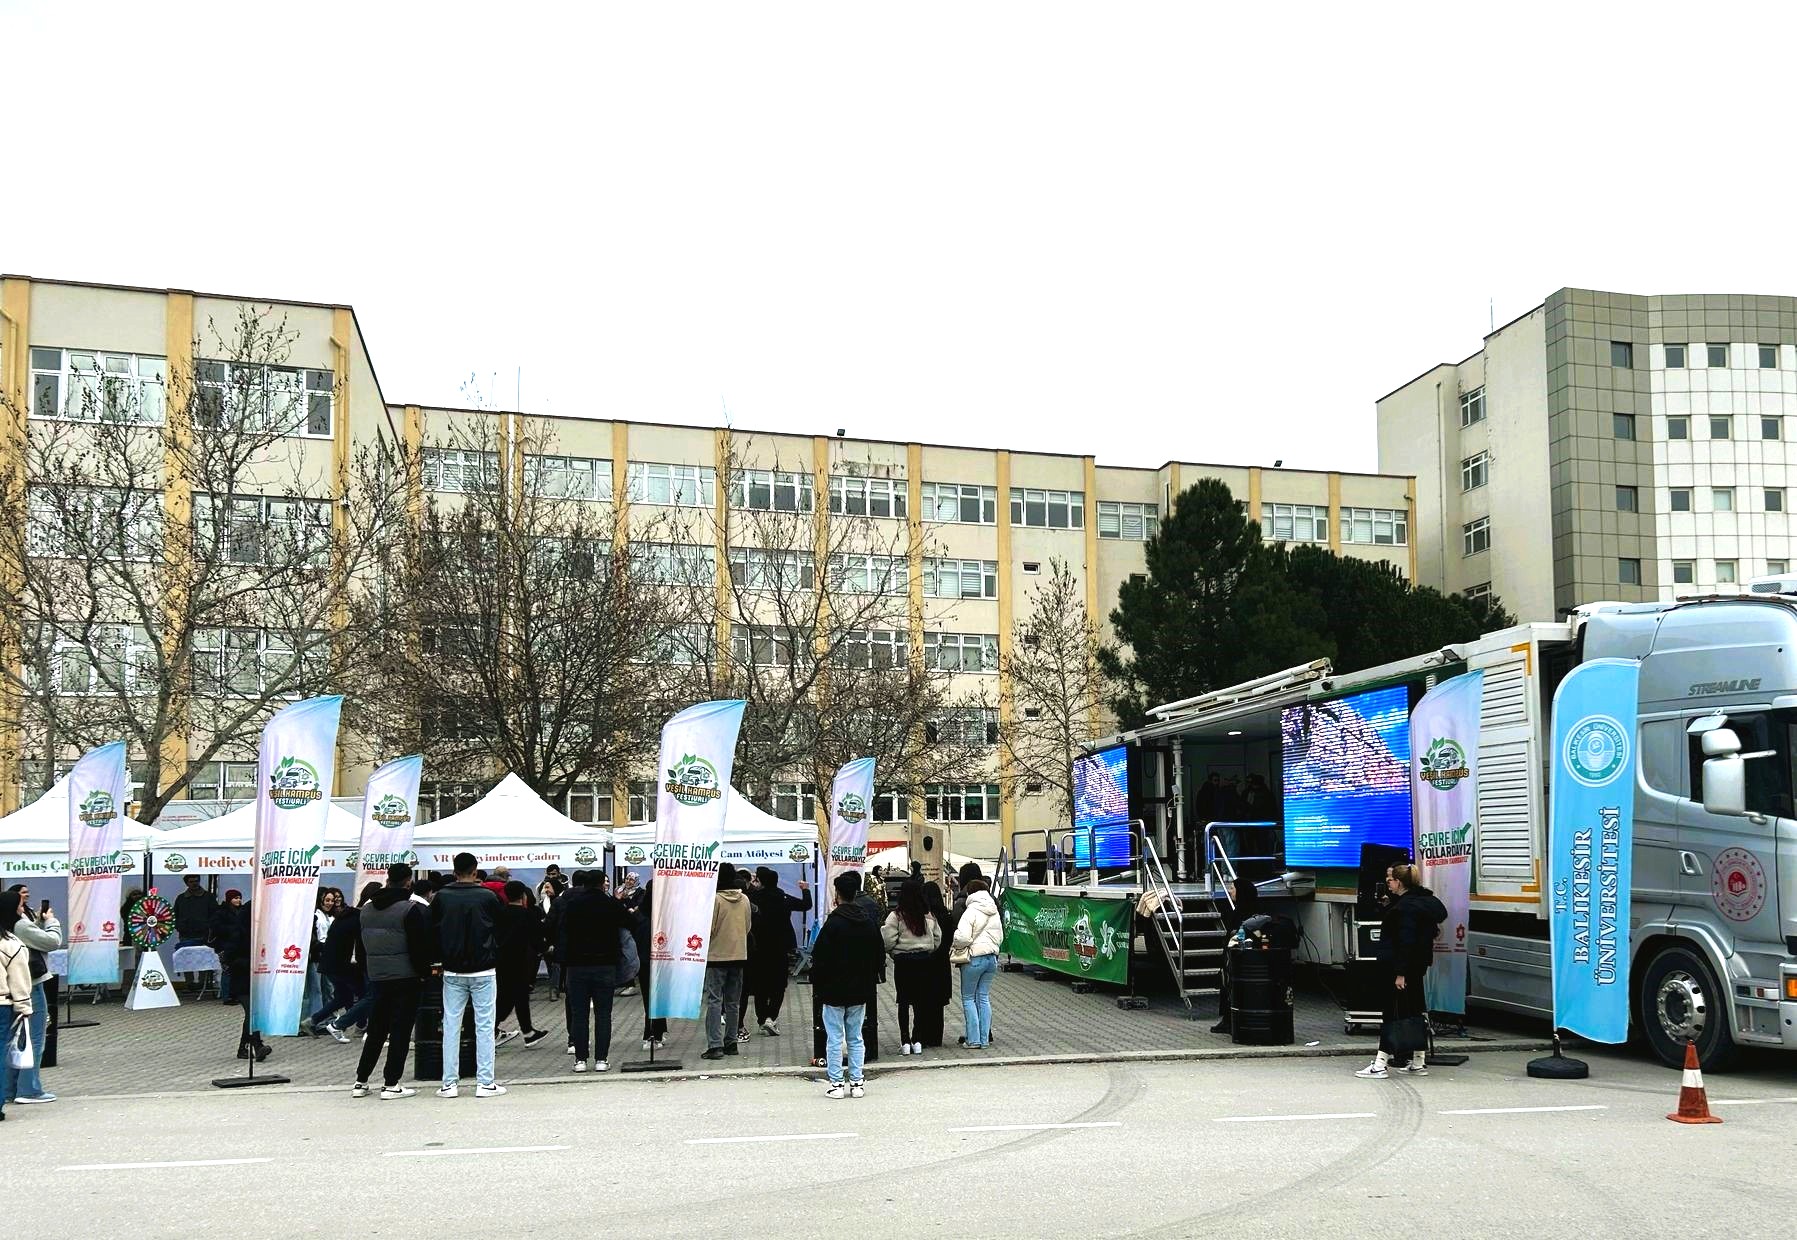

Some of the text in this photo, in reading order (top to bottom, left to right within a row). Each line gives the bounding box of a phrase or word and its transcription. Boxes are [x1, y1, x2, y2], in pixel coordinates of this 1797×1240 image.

[1688, 678, 1761, 696] STREAMLINE
[433, 854, 449, 863] VR
[527, 852, 561, 863] Çadırı
[690, 843, 713, 860] İÇİN
[720, 850, 743, 858] Cam
[745, 849, 783, 860] Atölyesi
[4, 860, 48, 873] Tokuş
[198, 856, 247, 871] Hediye
[653, 858, 719, 872] YOLLARDAYIZ
[1555, 877, 1568, 914] T.C.
[1570, 828, 1592, 964] BALIKESİR
[1594, 806, 1620, 986] ÜNİVERSİTESİ
